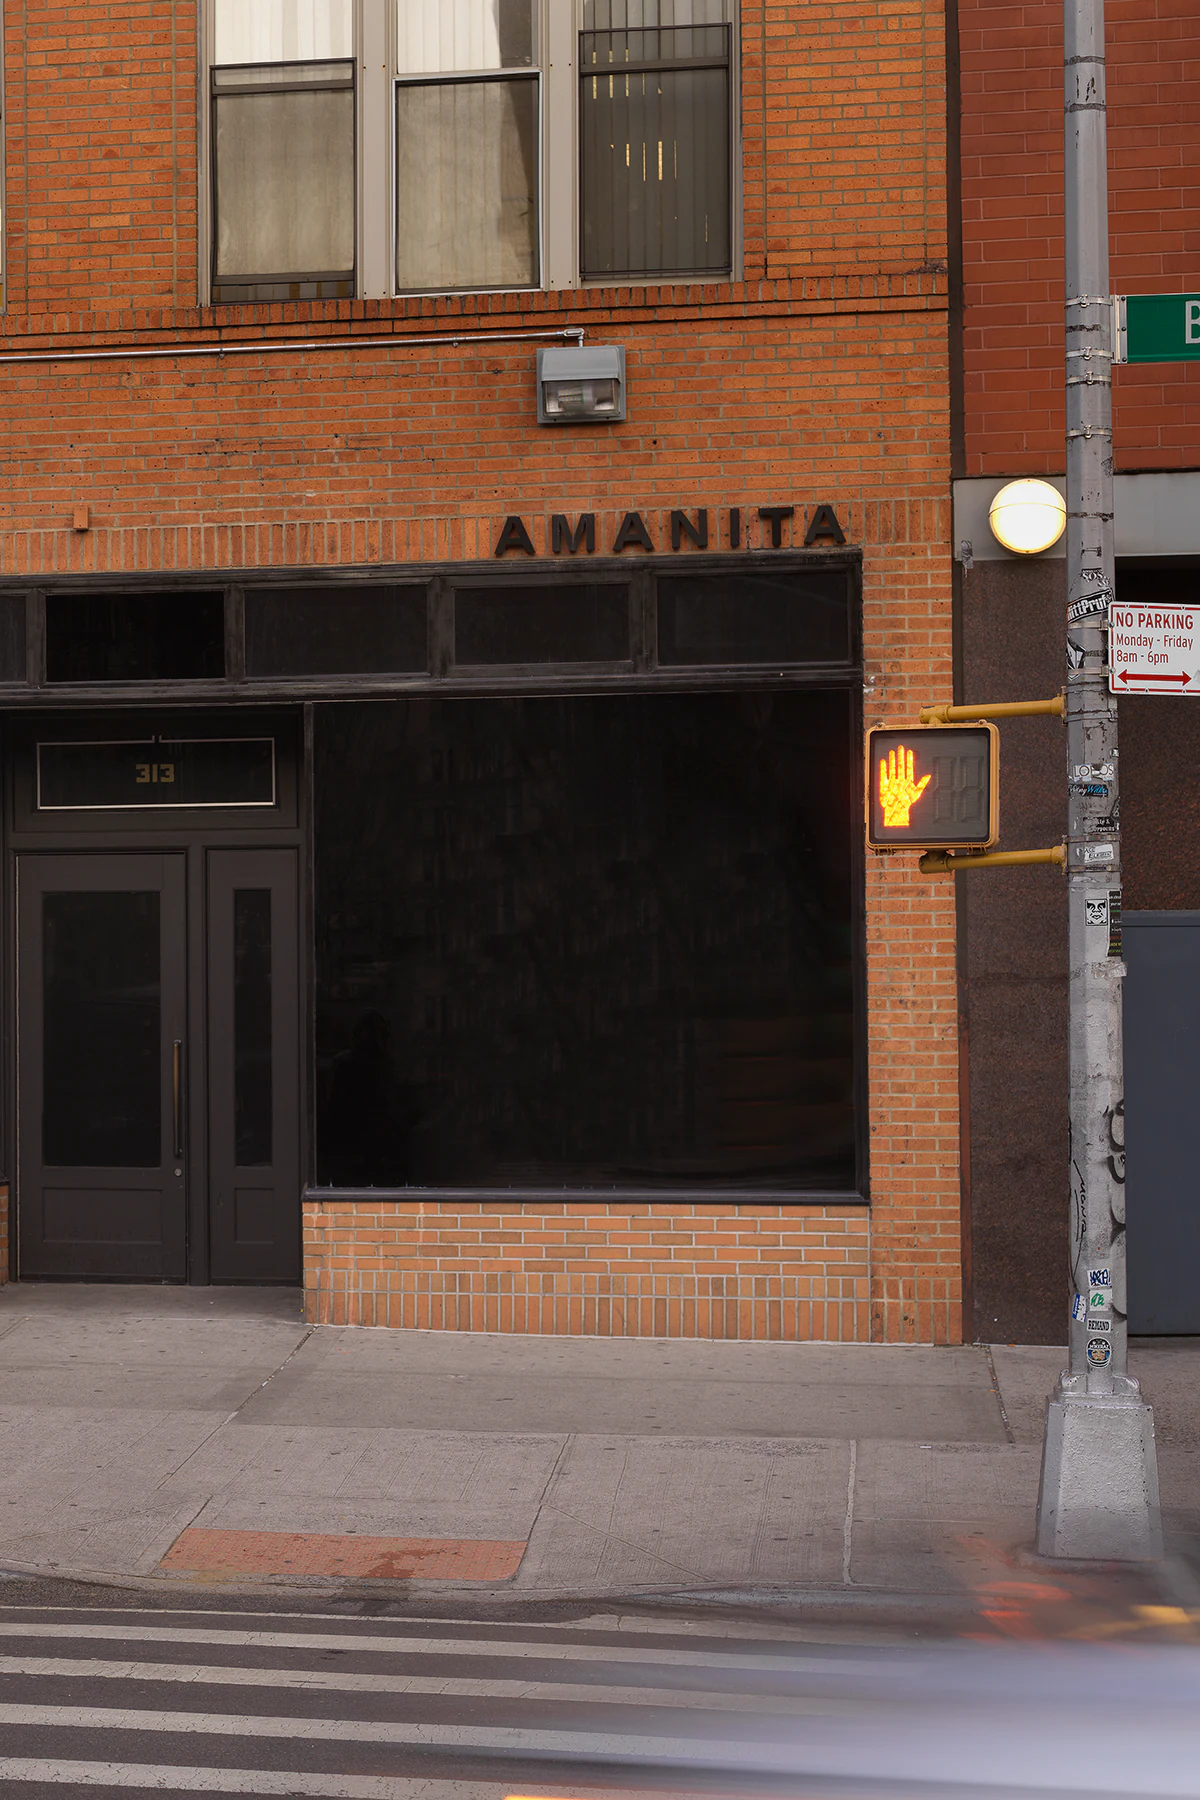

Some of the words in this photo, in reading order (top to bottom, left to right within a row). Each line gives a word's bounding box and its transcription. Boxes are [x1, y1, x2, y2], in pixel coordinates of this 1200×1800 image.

[1185, 299, 1200, 344] B
[494, 504, 847, 554] AMANITA
[1116, 612, 1133, 628] NO
[1138, 613, 1194, 630] PARKING
[1116, 633, 1154, 649] Monday
[1164, 635, 1194, 651] Friday
[1116, 650, 1138, 663] 8am
[1147, 651, 1169, 665] 6pm
[136, 763, 175, 783] 313
